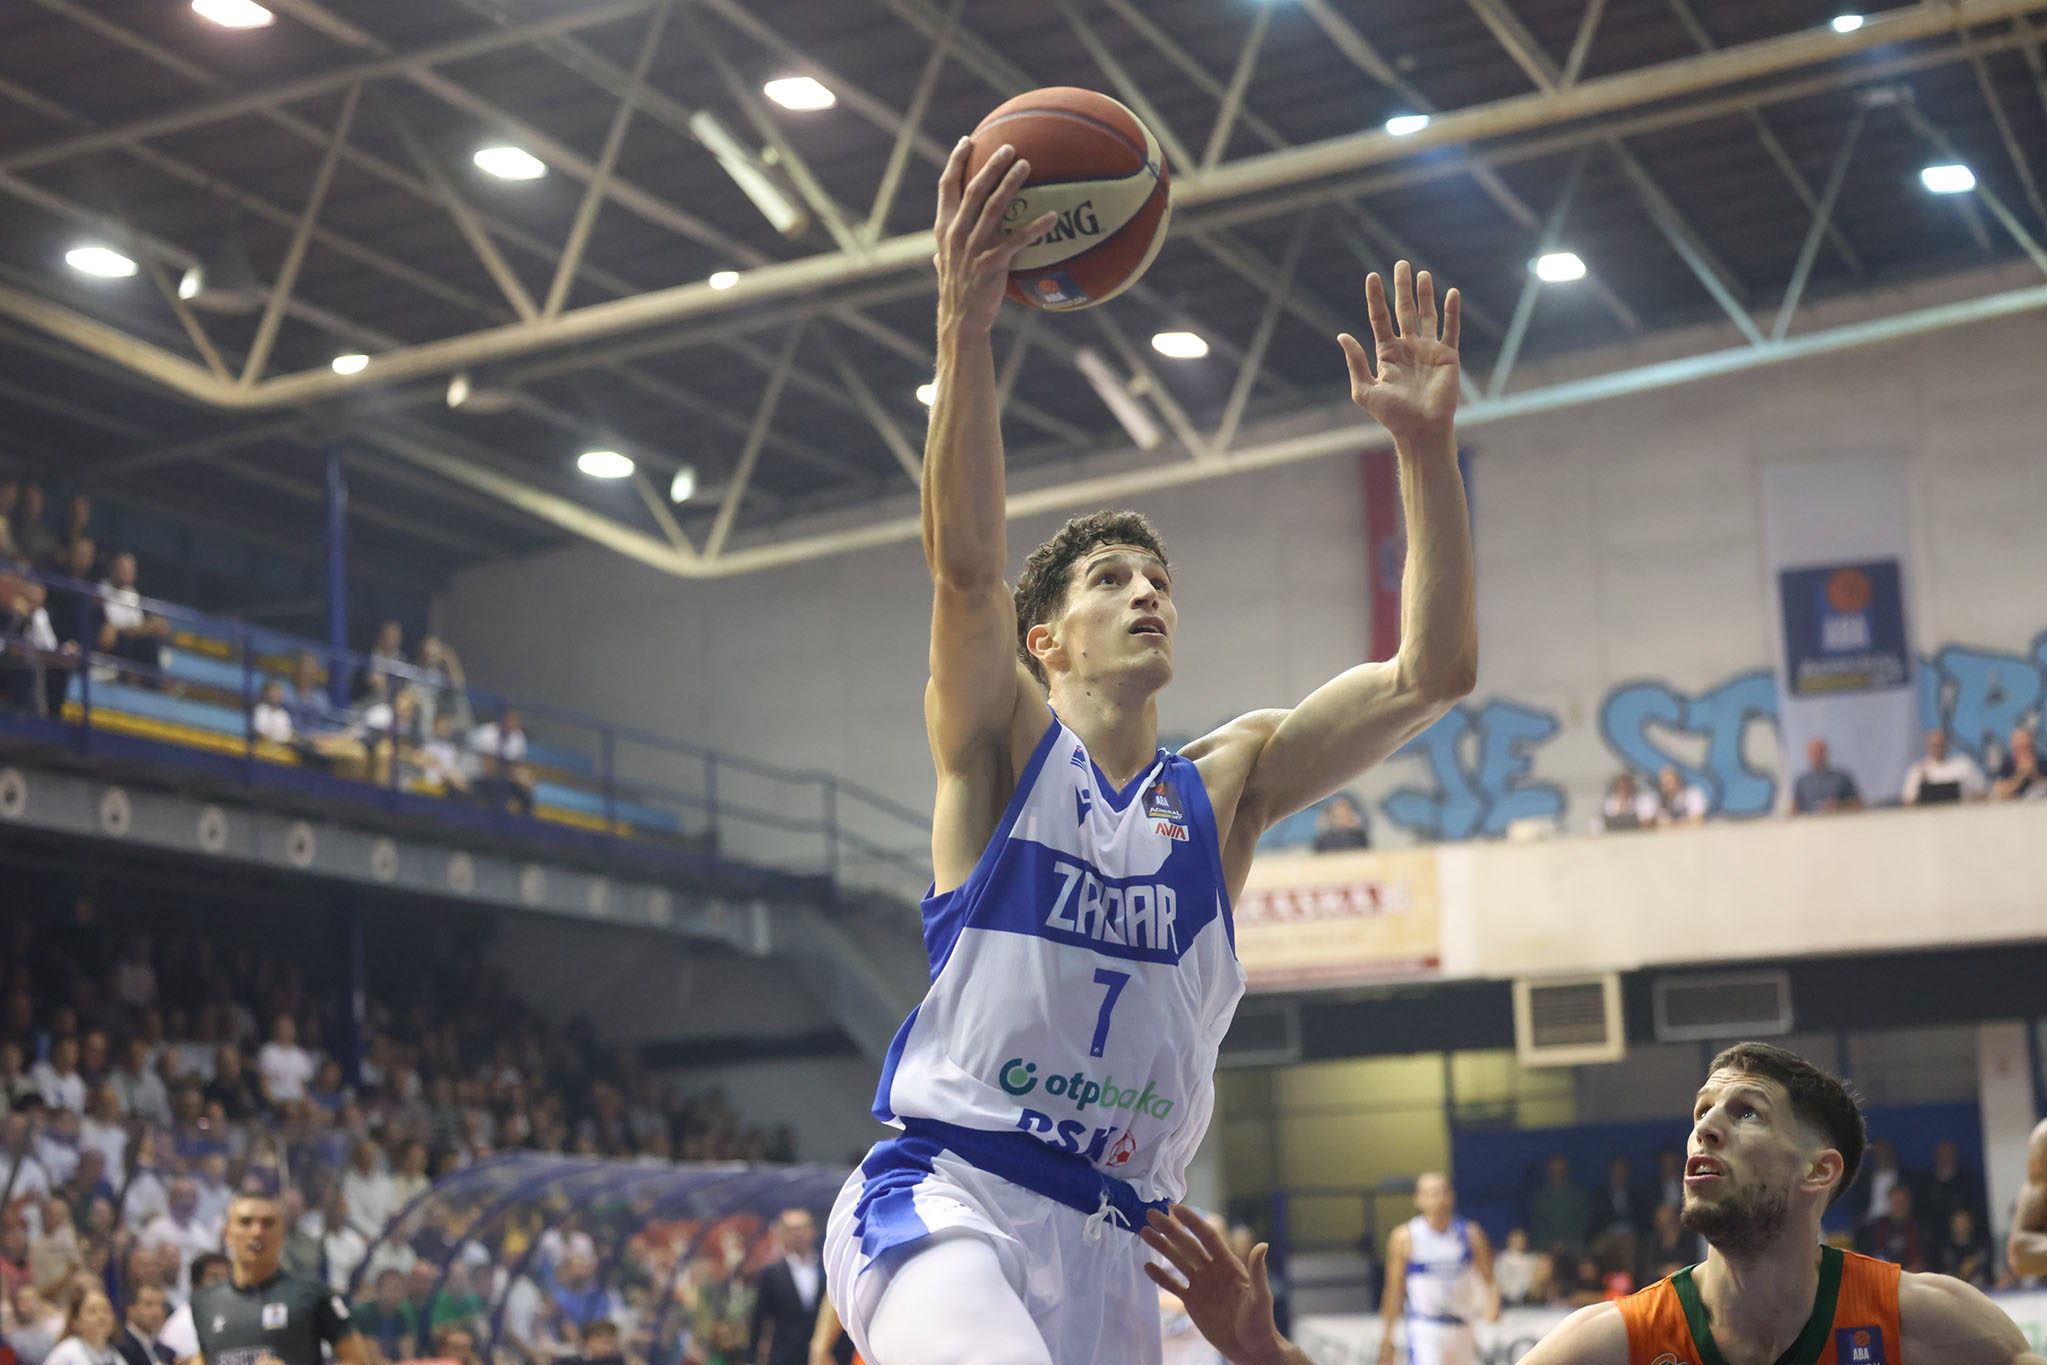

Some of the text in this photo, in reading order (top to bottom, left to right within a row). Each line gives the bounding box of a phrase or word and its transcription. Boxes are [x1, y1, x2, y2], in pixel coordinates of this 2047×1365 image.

[1155, 822, 1186, 840] AVIA
[1045, 861, 1179, 955] ZADAR
[1089, 967, 1132, 1058] 7
[1045, 1072, 1175, 1121] otpbaka
[1853, 1347, 1870, 1360] ABA
